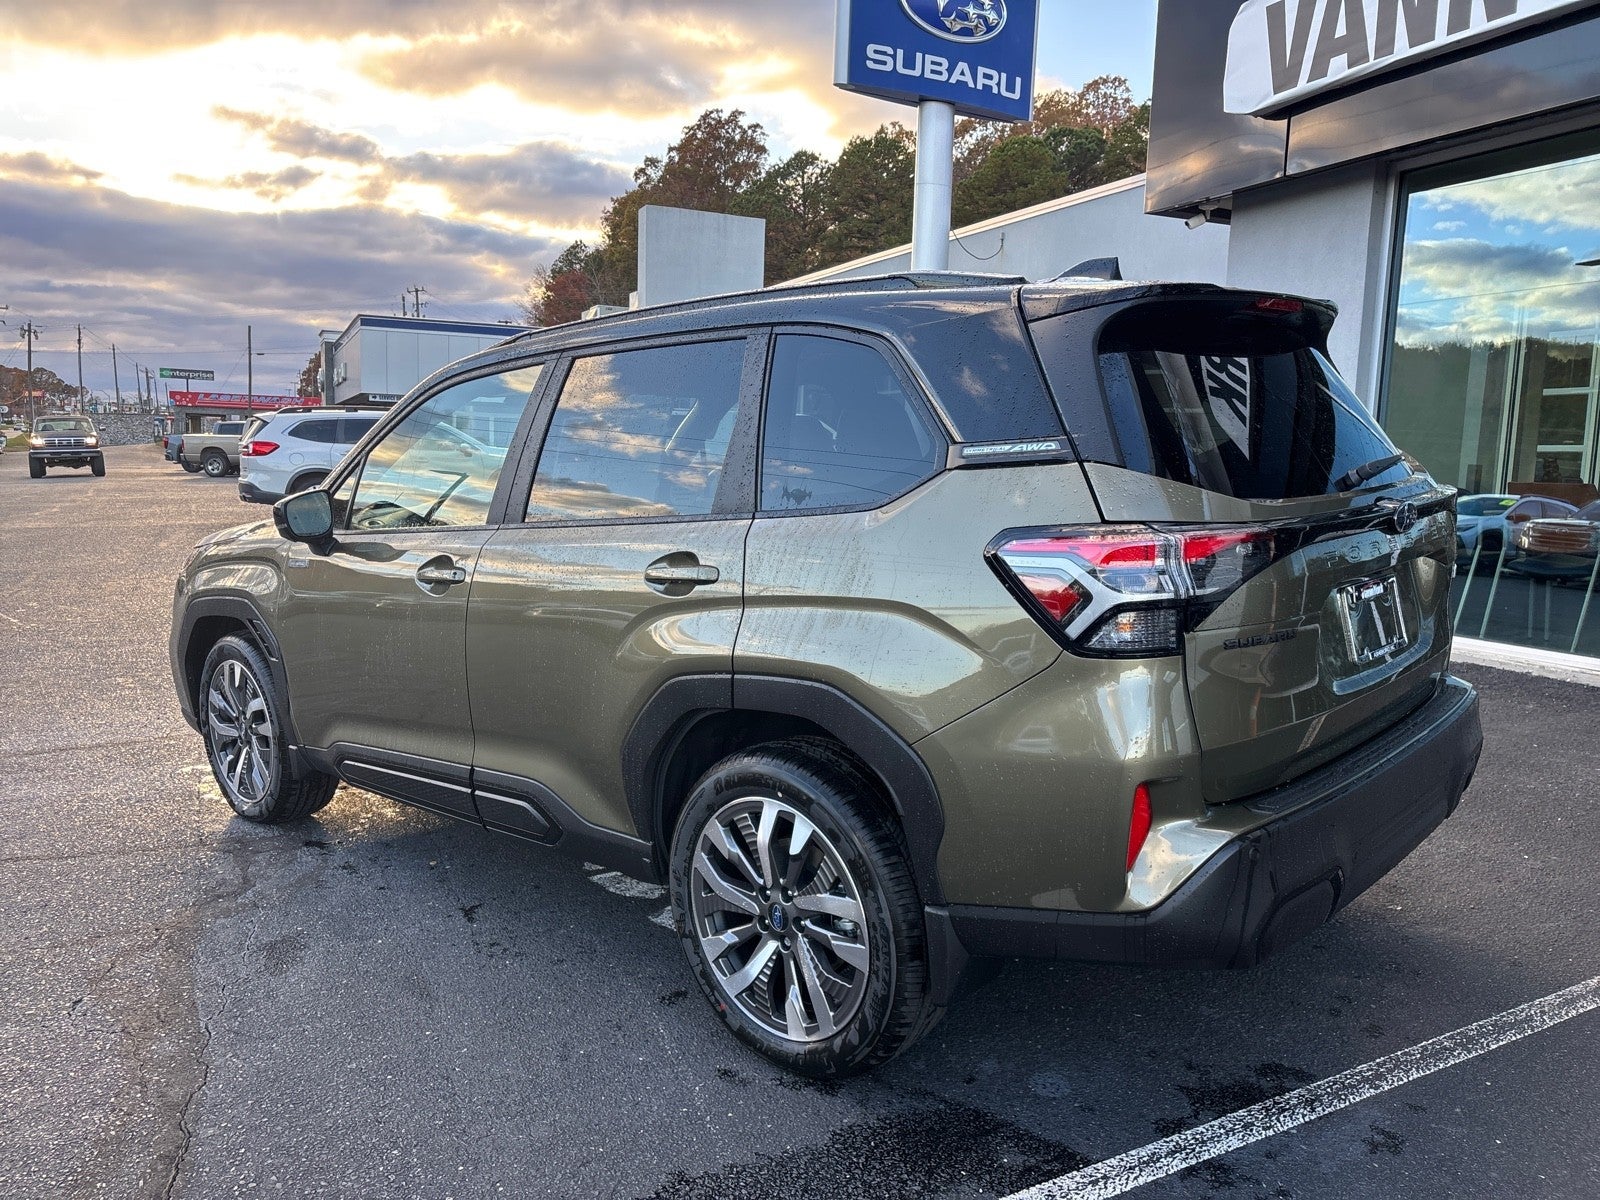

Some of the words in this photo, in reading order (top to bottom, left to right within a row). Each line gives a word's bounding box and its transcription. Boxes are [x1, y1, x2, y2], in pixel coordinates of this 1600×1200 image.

[865, 43, 1022, 100] SUBARU
[163, 370, 214, 378] enterprise
[1010, 441, 1056, 453] AWD
[1223, 629, 1299, 650] SUBARU
